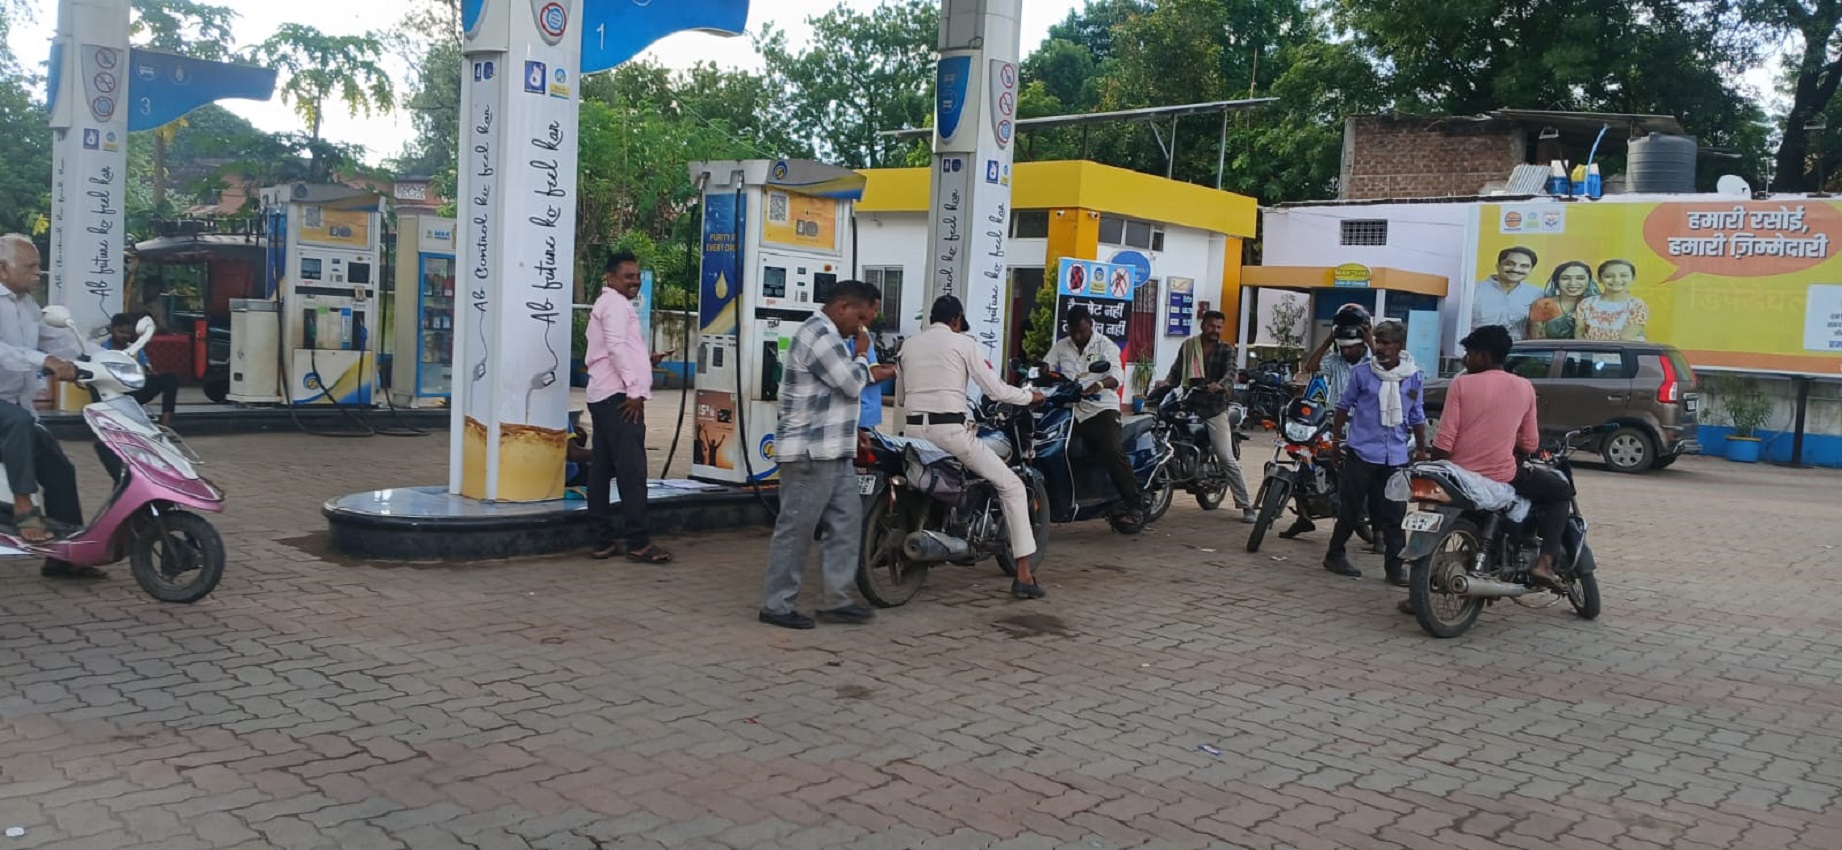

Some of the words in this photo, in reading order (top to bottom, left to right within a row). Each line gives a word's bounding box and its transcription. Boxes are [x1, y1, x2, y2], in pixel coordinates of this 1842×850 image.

[596, 22, 605, 51] 1
[139, 97, 151, 116] 3
[477, 105, 493, 134] kar
[532, 120, 564, 151] kar
[475, 142, 493, 176] feel
[88, 165, 115, 185] kar
[530, 159, 566, 198] feel
[86, 190, 117, 215] feel
[944, 188, 960, 211] kar
[529, 207, 561, 228] ko
[988, 202, 1005, 225] kar
[1687, 204, 1746, 230] हमारी
[1749, 204, 1809, 234] रसोई,
[943, 215, 960, 242] feel
[89, 240, 116, 275] future
[474, 213, 488, 279] Control
[986, 230, 1005, 258] feel
[1667, 232, 1727, 257] हमारी
[532, 236, 563, 290] future
[526, 298, 560, 325] Ab
[983, 285, 1000, 324] future
[1104, 302, 1126, 318] नहीं
[1105, 320, 1127, 336] नहीं
